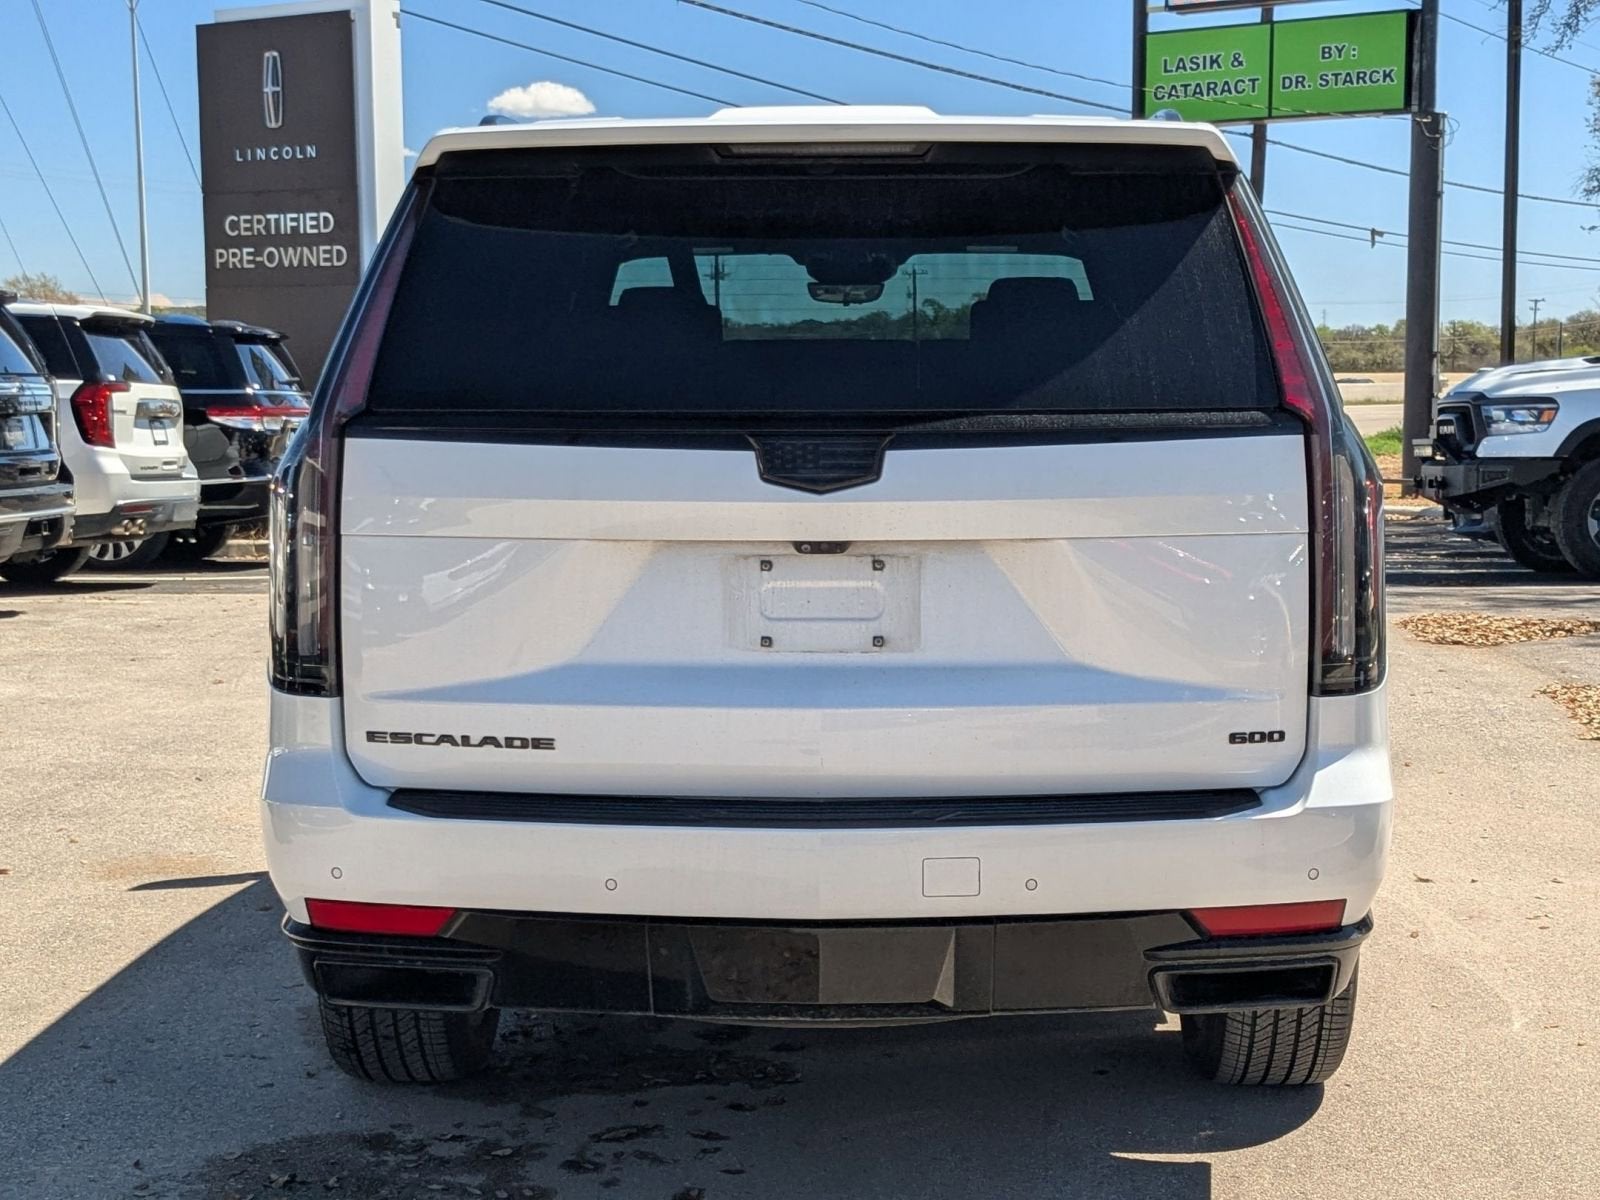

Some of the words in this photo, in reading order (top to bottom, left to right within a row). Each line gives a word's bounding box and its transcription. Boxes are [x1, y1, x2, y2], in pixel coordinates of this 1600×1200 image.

[1162, 53, 1223, 75] LASIK
[1230, 51, 1245, 69] &
[1152, 77, 1261, 102] CATARACT
[1280, 74, 1313, 91] DR.
[1318, 68, 1397, 89] STARCK
[235, 144, 318, 163] LINCOLN
[224, 211, 335, 237] CERTIFIED
[215, 244, 348, 269] PRE-OWNED
[366, 730, 556, 750] ESCALADE
[1228, 730, 1286, 745] 600
